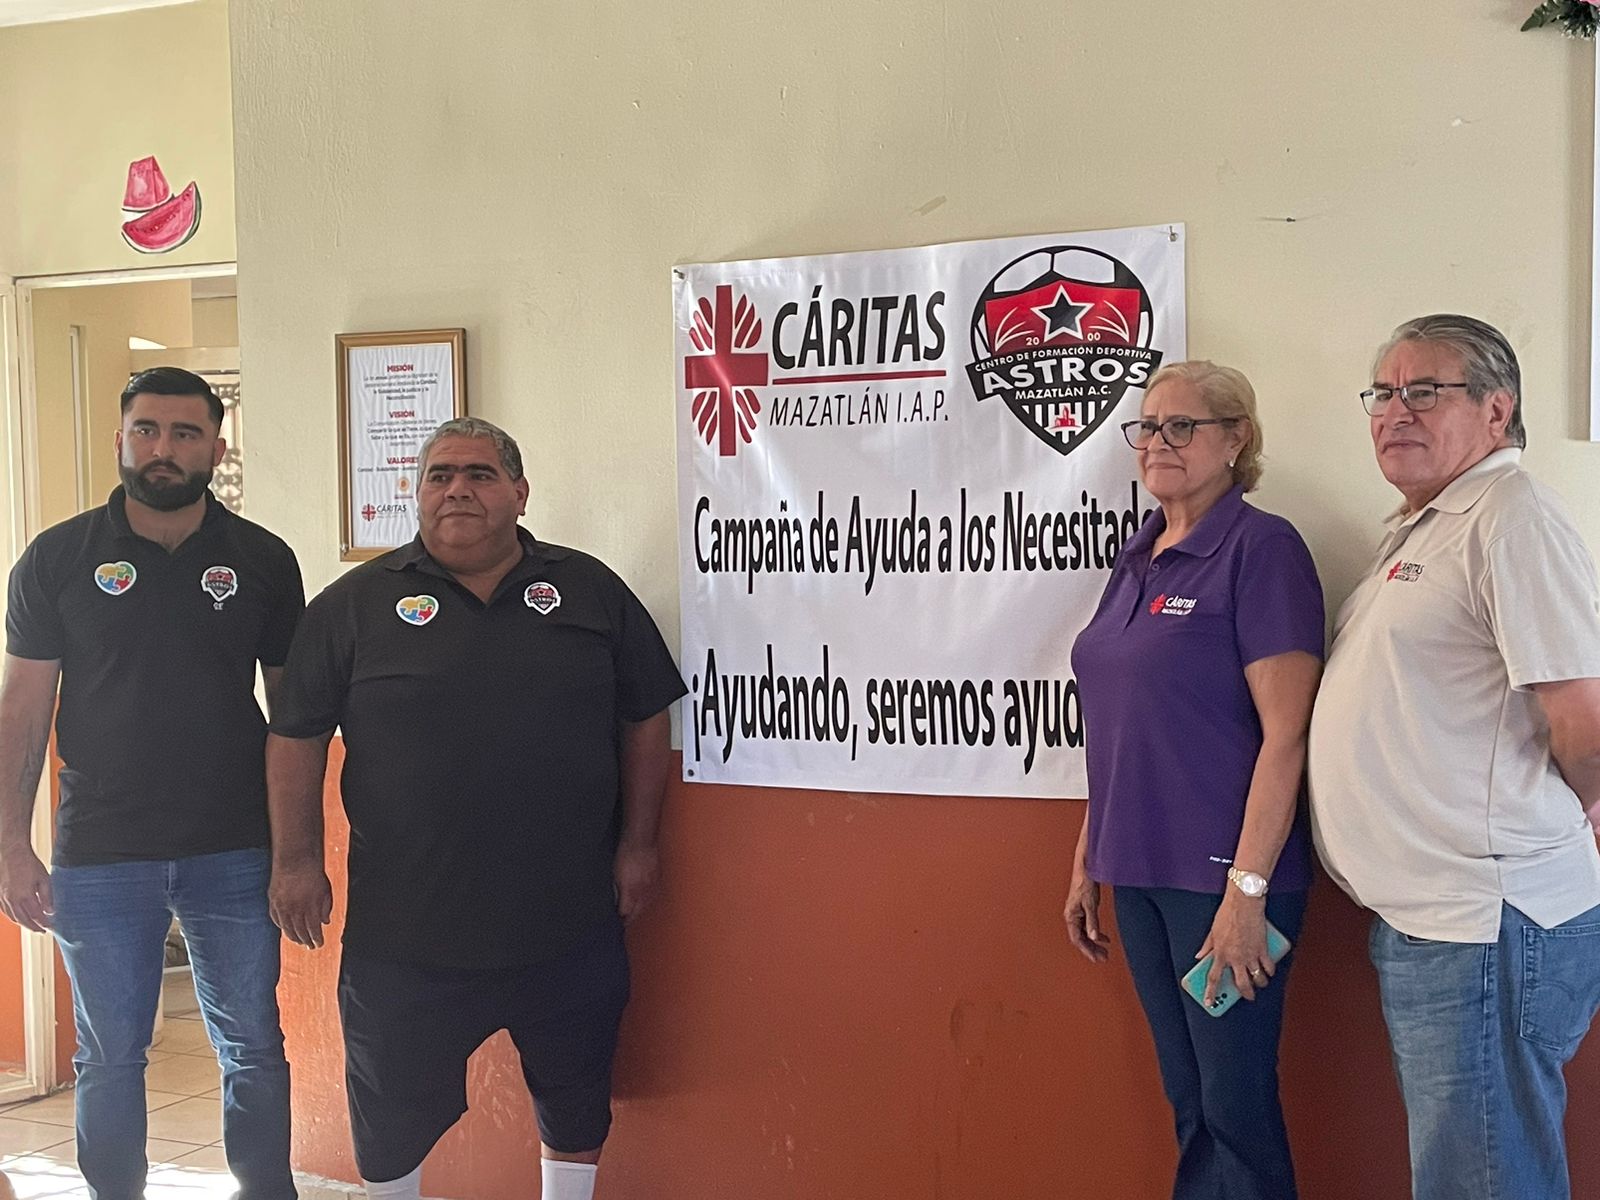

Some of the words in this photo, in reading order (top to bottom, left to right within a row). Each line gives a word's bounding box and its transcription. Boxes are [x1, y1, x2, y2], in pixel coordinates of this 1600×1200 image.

[772, 285, 946, 370] CÁRITAS
[1086, 332, 1101, 342] 00
[1025, 336, 1040, 346] 20
[387, 364, 414, 372] MISIÓN
[975, 354, 1015, 372] CENTRO
[1017, 350, 1030, 361] DE
[1032, 346, 1094, 359] FORMACIÓN
[1096, 347, 1152, 360] DEPORTIVA
[983, 357, 1151, 394] ASTROS
[1015, 385, 1084, 400] MAZATLÁN
[1087, 384, 1112, 396] A.C.
[389, 410, 416, 418] VISIÓN
[769, 386, 889, 427] MAZATLÁN
[897, 389, 949, 423] I.A.P.
[376, 504, 407, 513] CÁRITAS
[694, 496, 805, 594] Campaña
[810, 490, 839, 573] de
[844, 489, 931, 596] Ayuda
[937, 516, 952, 573] a
[959, 488, 996, 573] los
[1002, 480, 1154, 572] Necesitad
[692, 643, 859, 764] ¡Ayudando,
[866, 678, 996, 747] seremos
